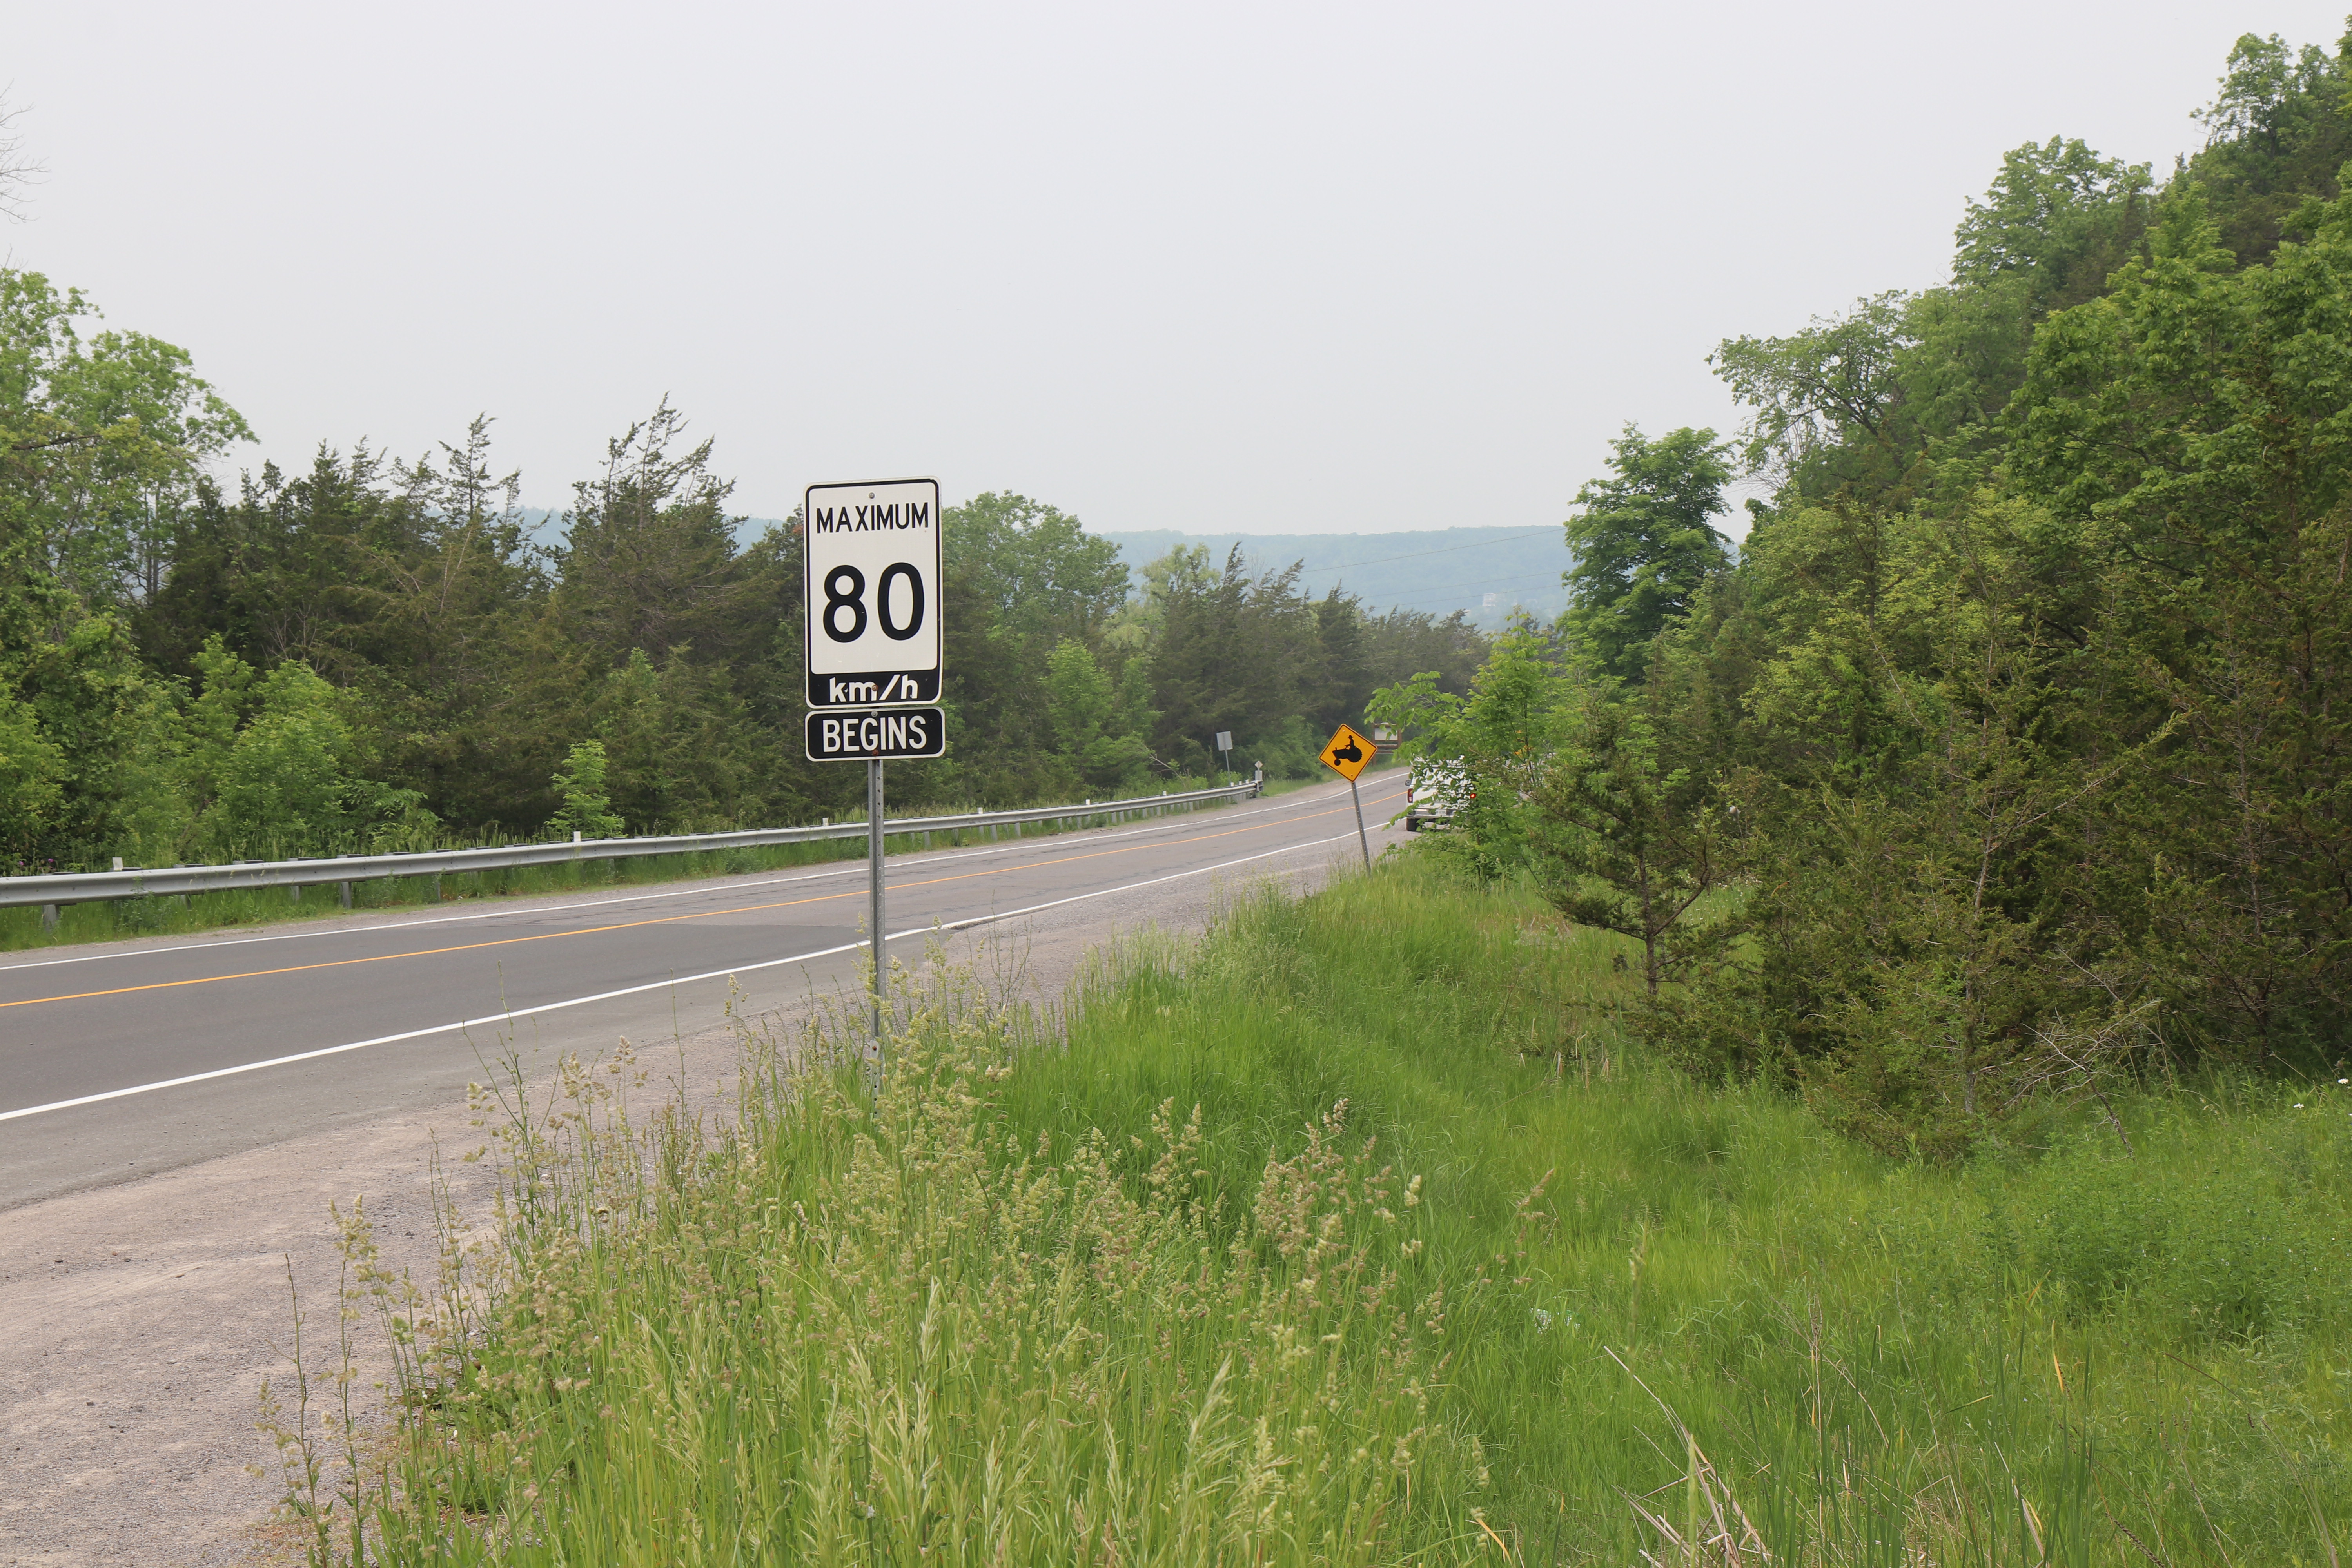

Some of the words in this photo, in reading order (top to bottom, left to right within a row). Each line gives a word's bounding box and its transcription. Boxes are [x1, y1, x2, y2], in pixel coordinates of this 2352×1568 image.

[817, 502, 928, 534] MAXIMUM
[823, 562, 924, 643] 80
[829, 674, 918, 702] km/h
[823, 715, 927, 752] BEGINS
